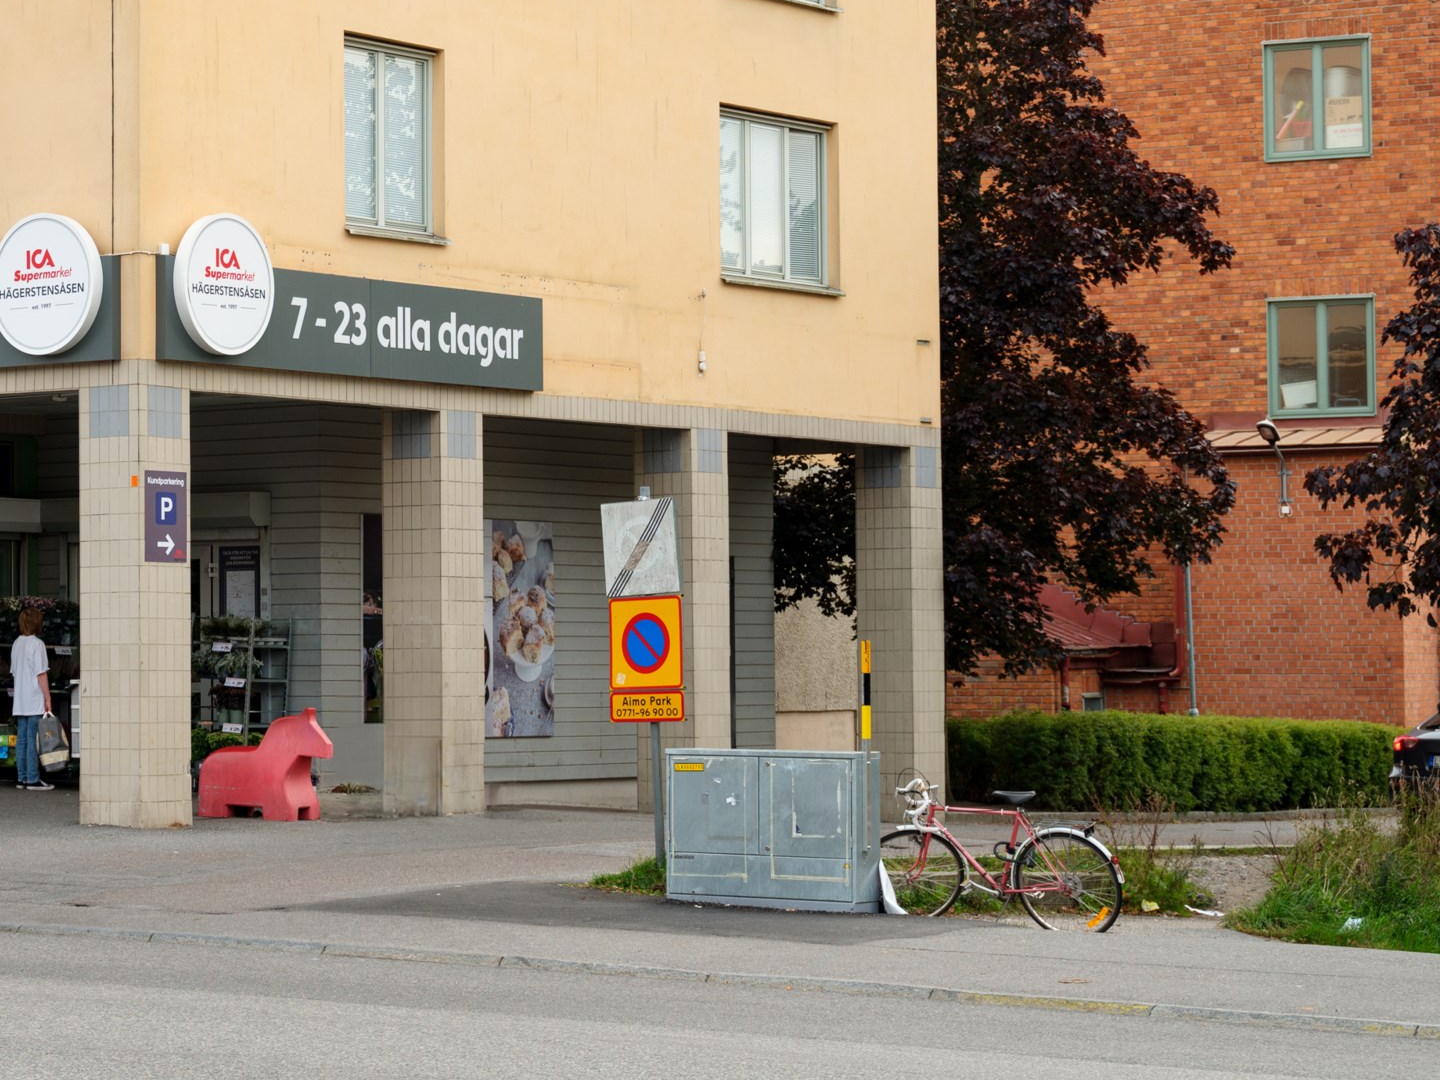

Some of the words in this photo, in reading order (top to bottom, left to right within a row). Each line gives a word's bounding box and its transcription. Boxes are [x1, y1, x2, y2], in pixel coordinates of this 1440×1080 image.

[26, 248, 55, 270] ICA
[215, 248, 241, 270] ICA
[14, 266, 73, 284] Supermarket
[205, 266, 256, 282] Supermarket
[0, 282, 85, 300] HÄGERSTENSÅSEN
[192, 282, 266, 300] HÄGERSTENSÅSEN
[291, 296, 308, 340] 7
[334, 301, 367, 346] 23
[377, 306, 431, 352] alla
[438, 312, 524, 367] dagar
[147, 476, 185, 487] Kundparkering
[161, 497, 173, 520] P
[622, 697, 647, 707] Aimo
[650, 696, 672, 706] Park
[616, 708, 650, 717] 0771-96
[652, 708, 664, 717] 90
[666, 708, 679, 717] 00
